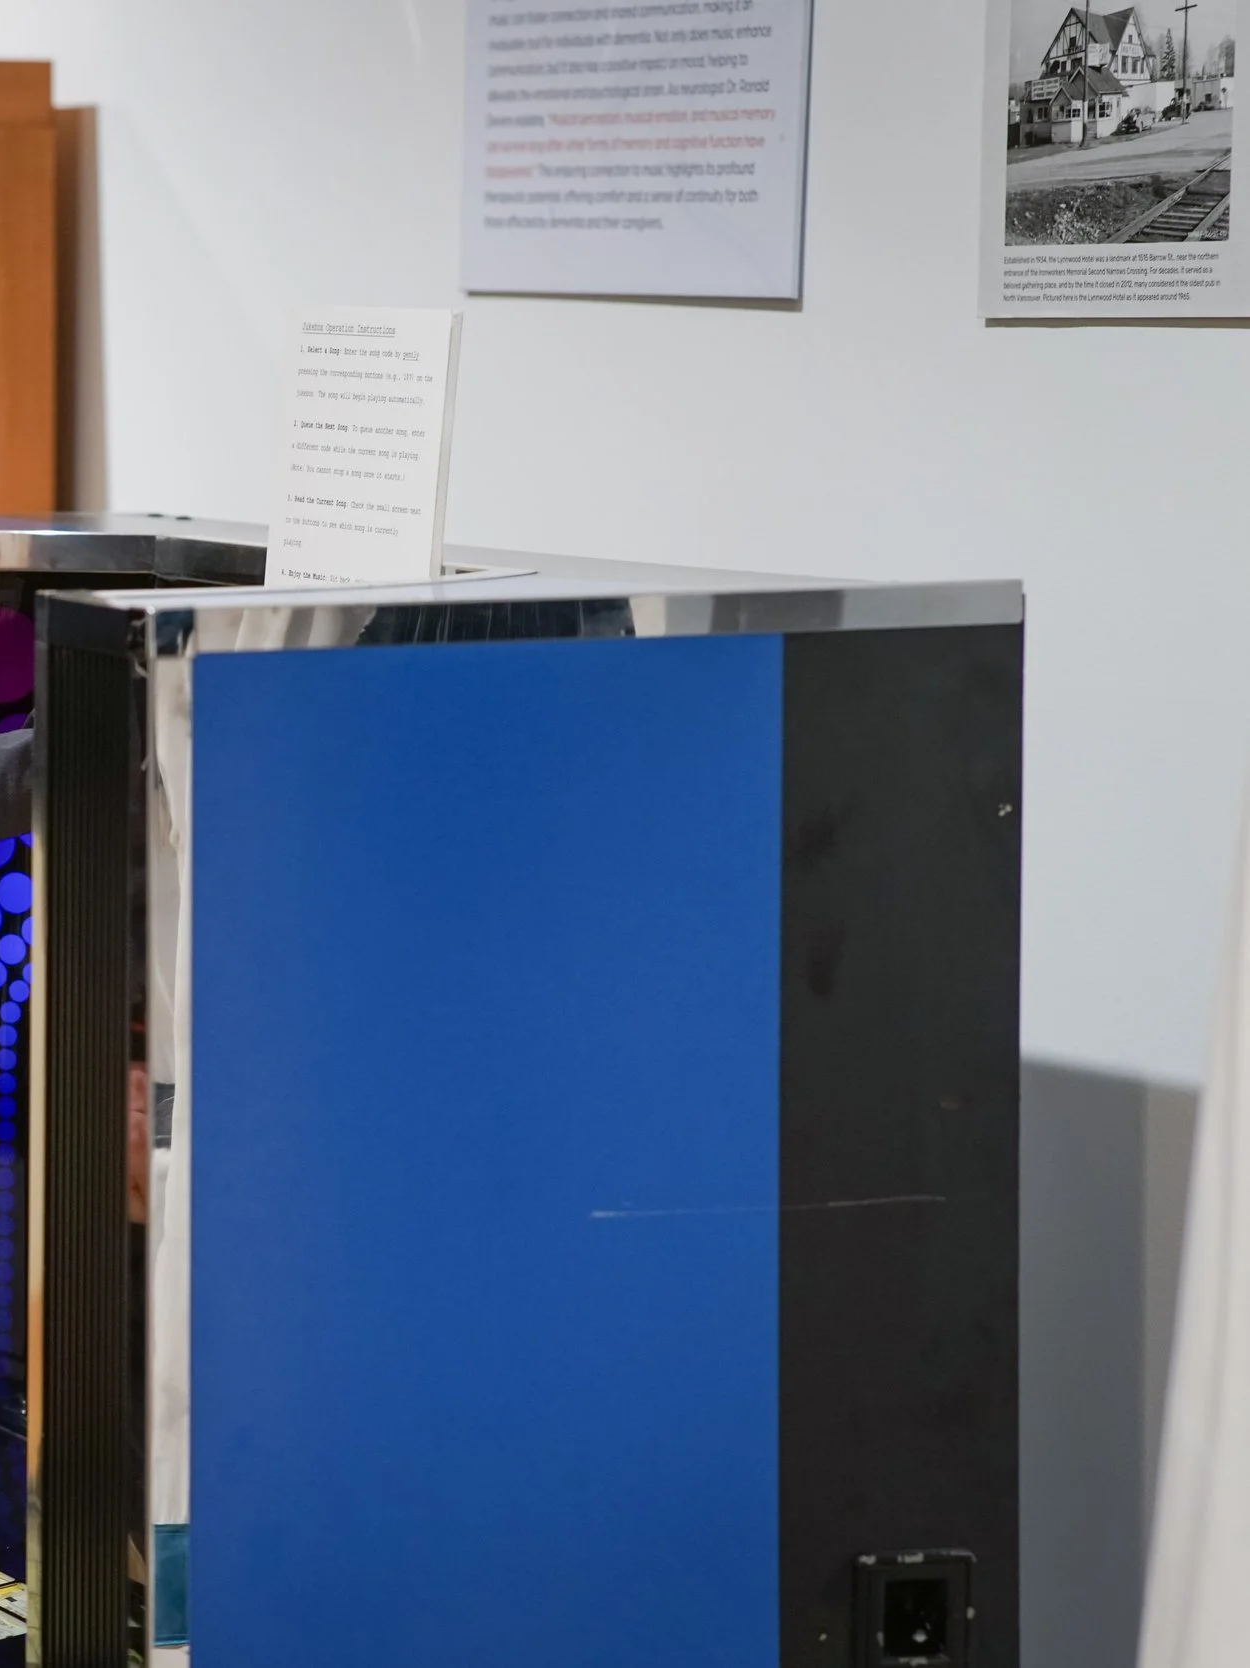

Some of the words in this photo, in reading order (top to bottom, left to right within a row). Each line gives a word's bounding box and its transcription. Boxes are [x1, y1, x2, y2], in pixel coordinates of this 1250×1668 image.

[326, 324, 354, 335] Operation
[357, 325, 395, 334] Instructions
[402, 351, 419, 360] gently
[368, 394, 386, 404] playing
[351, 501, 364, 509] Check
[375, 526, 398, 537] currently
